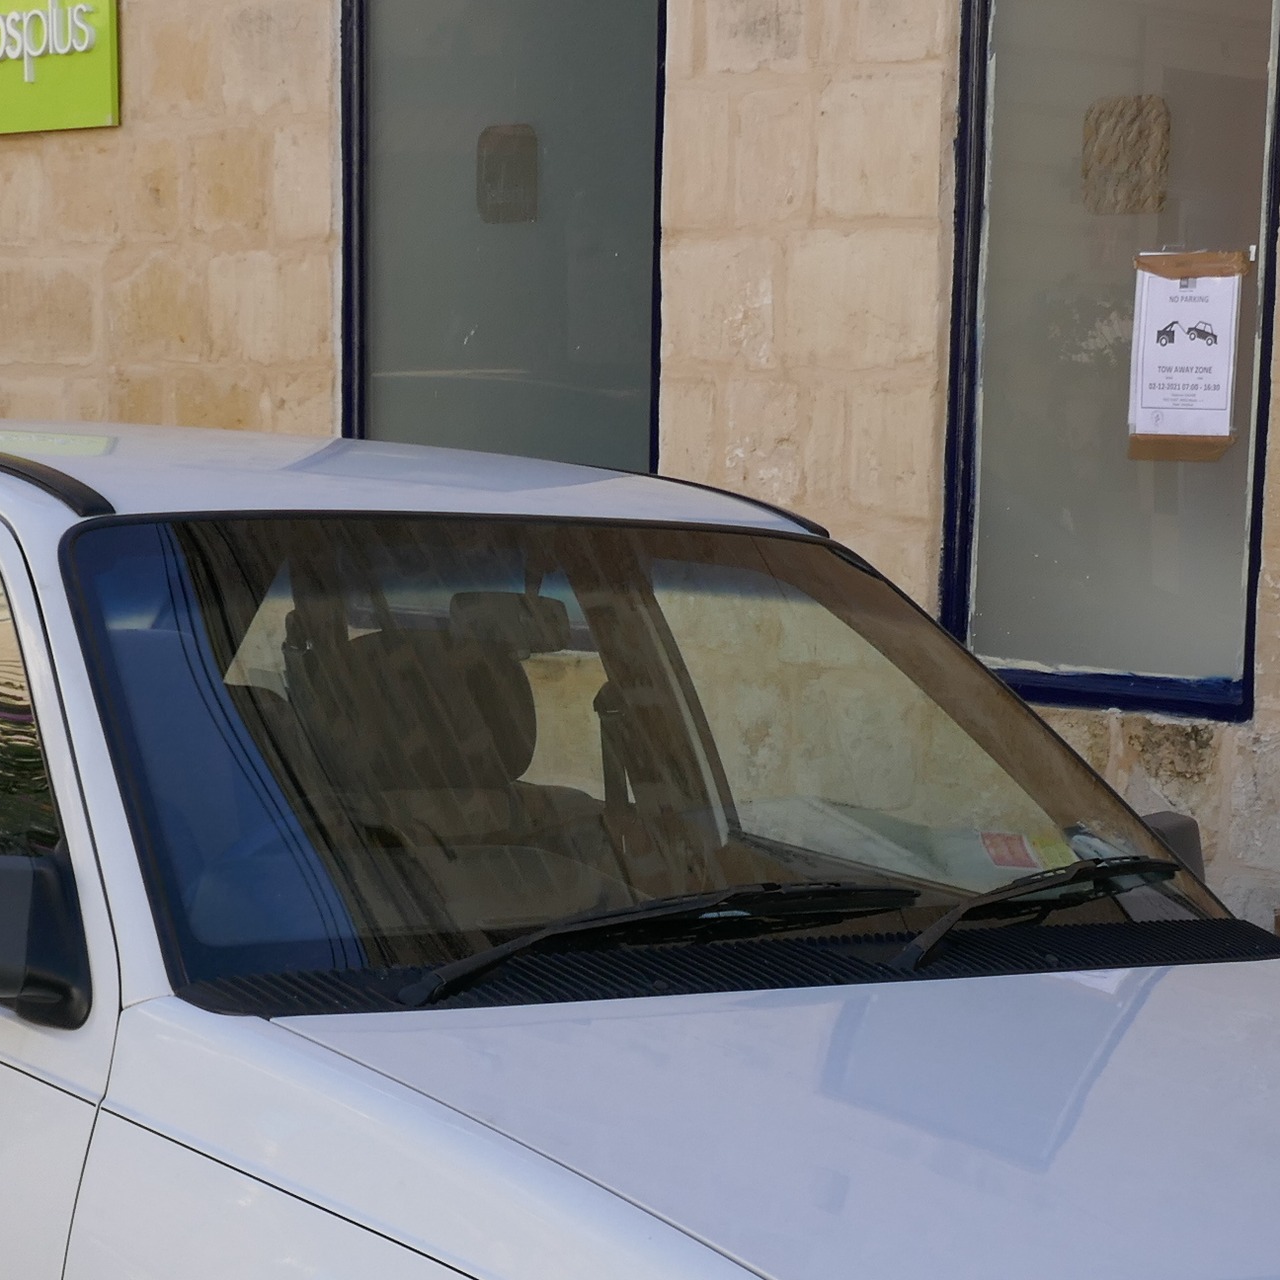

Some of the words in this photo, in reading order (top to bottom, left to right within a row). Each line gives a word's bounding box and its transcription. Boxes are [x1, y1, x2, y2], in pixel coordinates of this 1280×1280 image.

[1169, 295, 1179, 303] NO
[1180, 295, 1209, 303] PARKING
[1174, 366, 1194, 374] AWAY
[1194, 366, 1213, 374] ZONE
